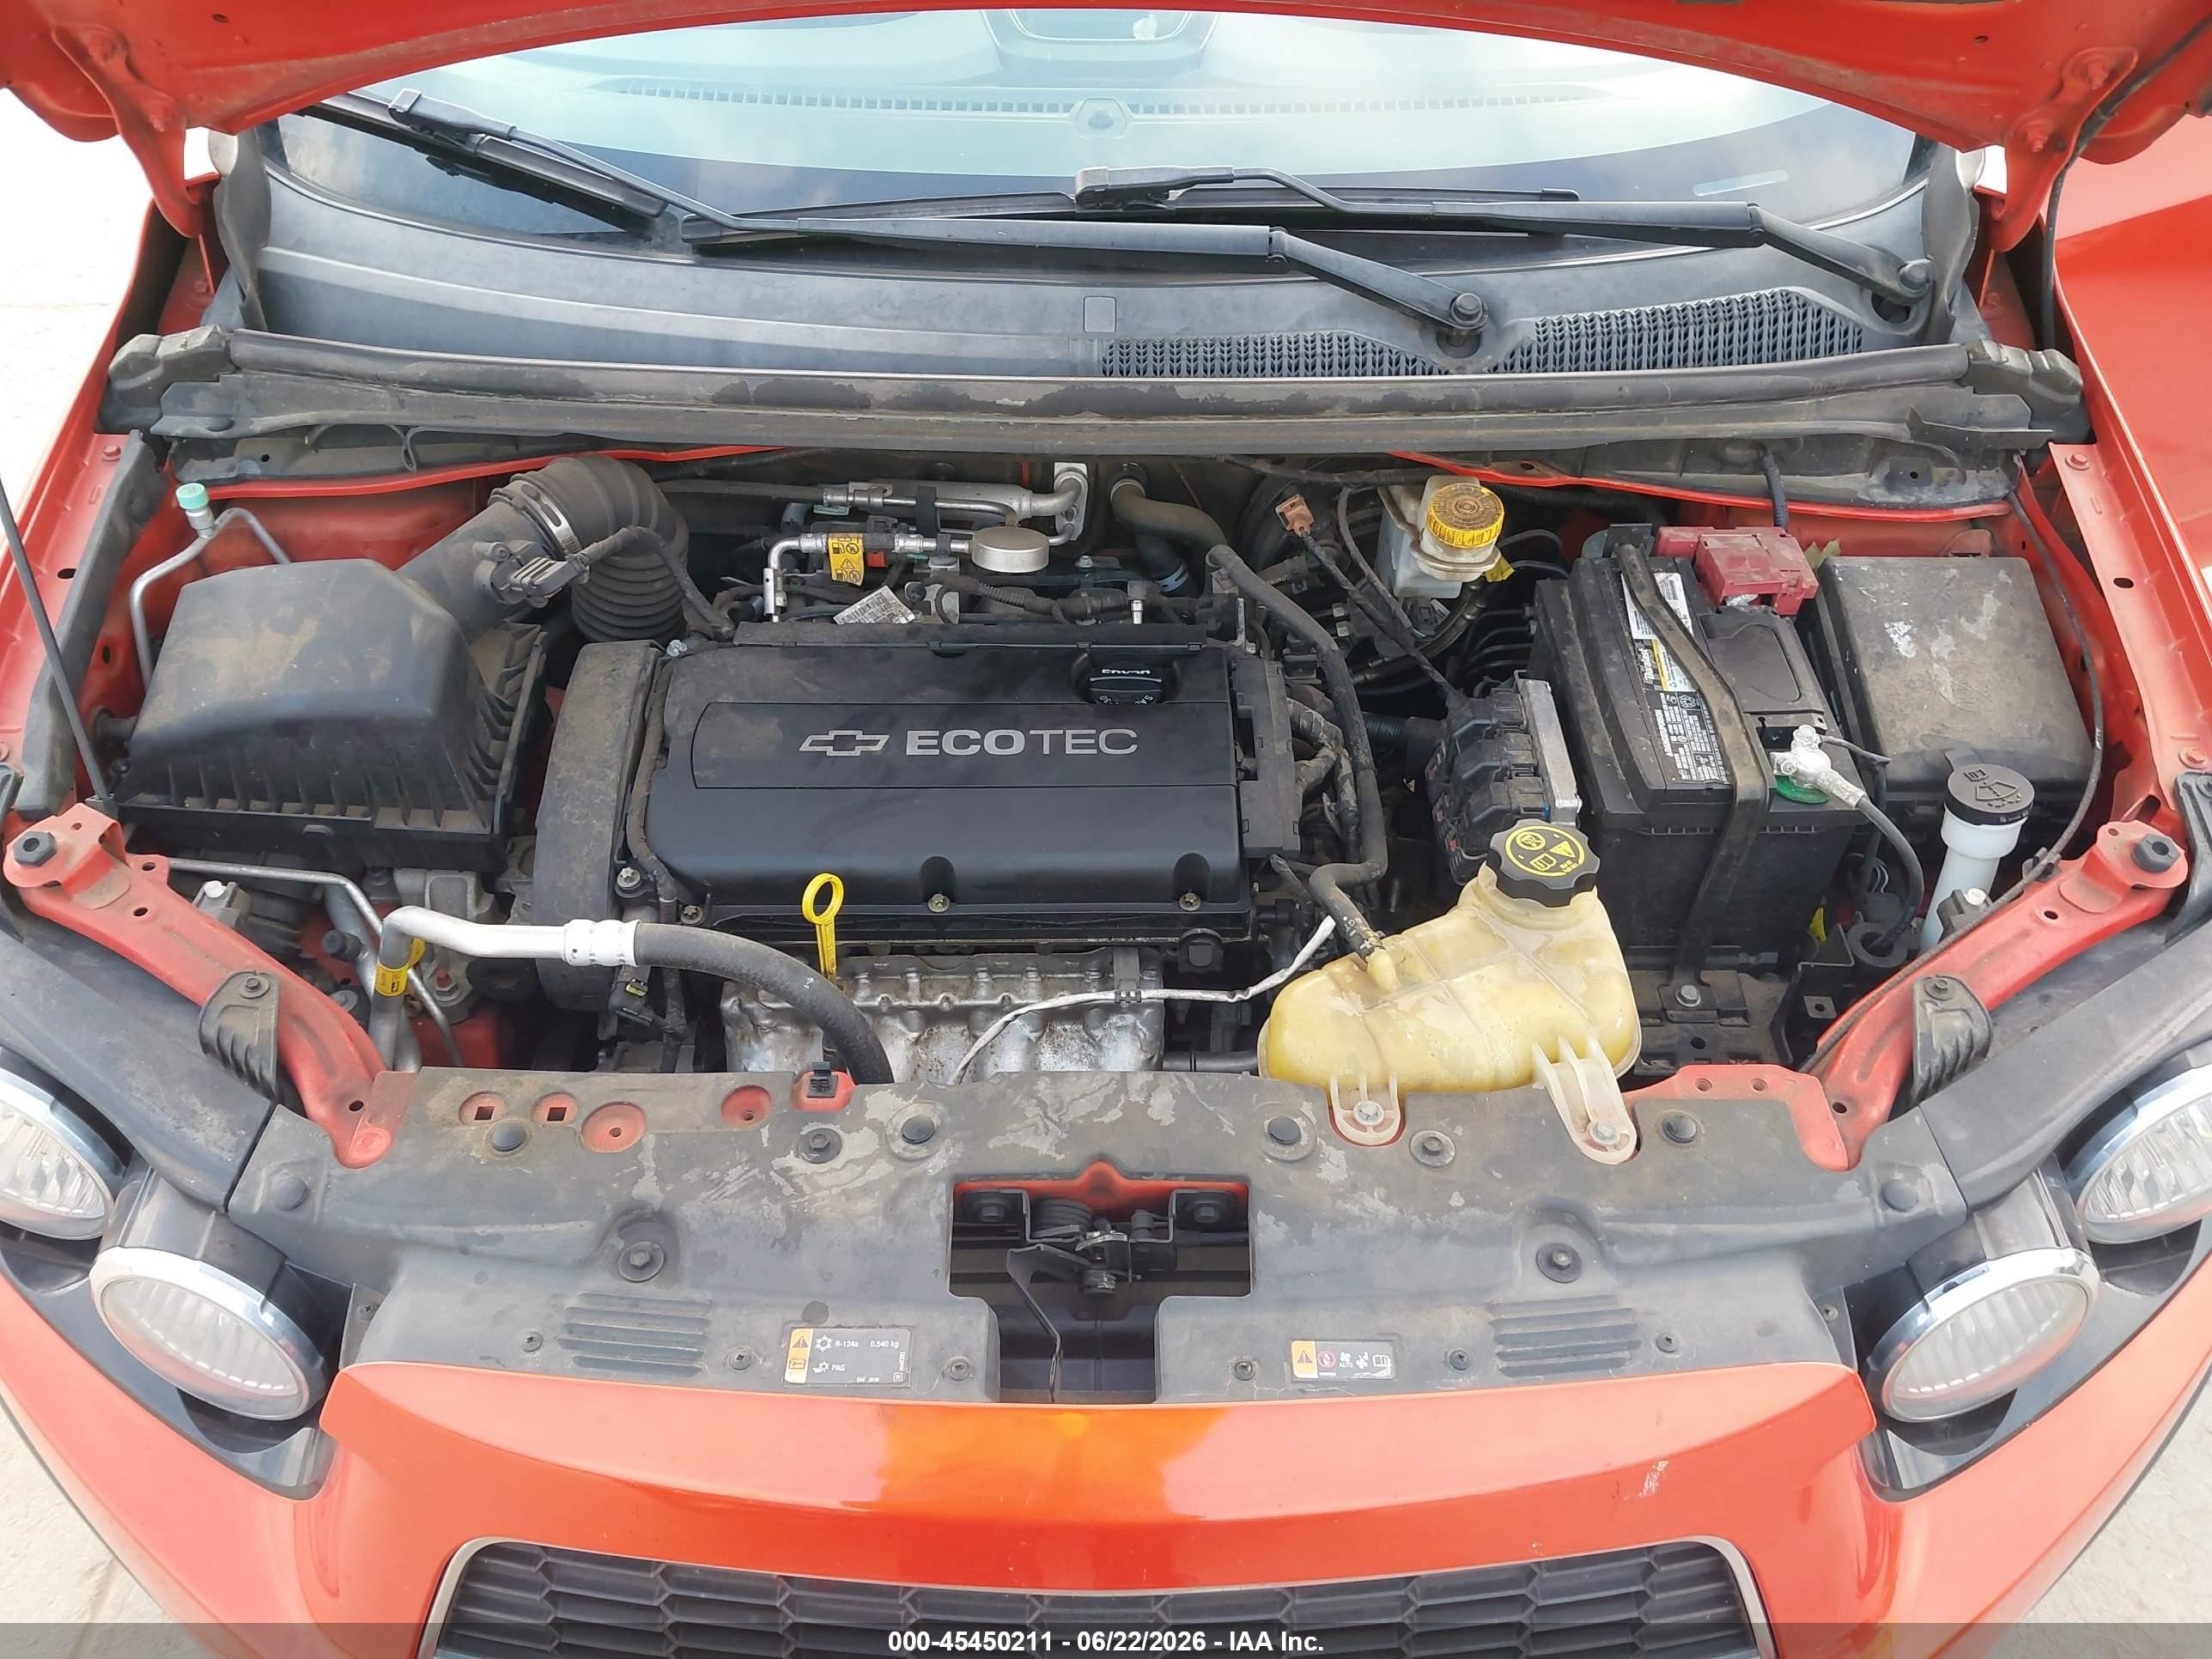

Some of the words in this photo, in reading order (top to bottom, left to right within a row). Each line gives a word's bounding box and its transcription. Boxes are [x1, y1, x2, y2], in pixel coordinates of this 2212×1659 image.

[1638, 647, 1656, 681] Duralast
[906, 729, 1137, 755] ECOTEC
[890, 1340, 900, 1349] kg
